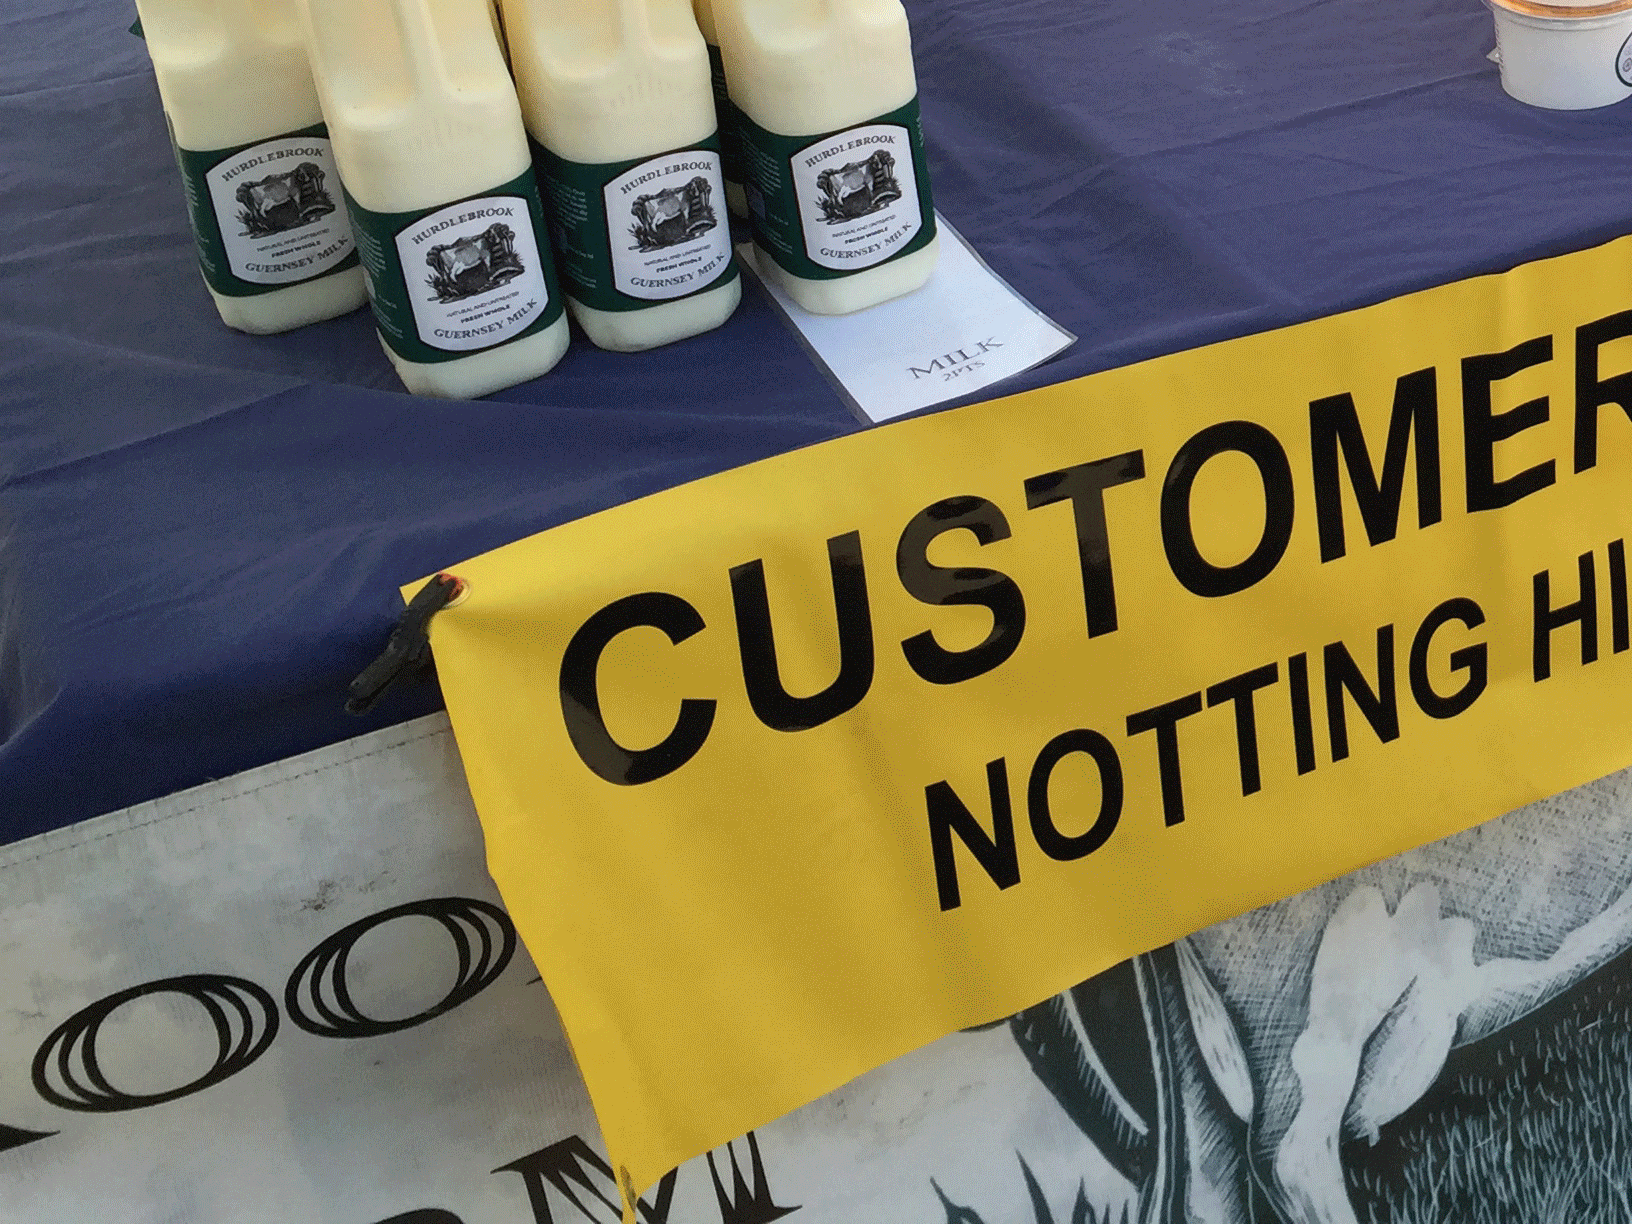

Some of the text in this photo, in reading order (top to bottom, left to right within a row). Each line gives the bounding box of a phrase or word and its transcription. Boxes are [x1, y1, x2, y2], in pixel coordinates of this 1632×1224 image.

[221, 147, 324, 182] HURDLEBROOK
[804, 134, 897, 168] HURDLEBROOK
[620, 161, 713, 195] HURDLEBROOK
[411, 207, 514, 245] HURDLEBROOK
[820, 221, 912, 259] GUERNSEY MILK
[245, 235, 349, 273] GUERNSEY MILK
[630, 251, 726, 288] GUERNSEY MILK
[433, 297, 538, 339] GUERNSEY MILK
[905, 335, 1004, 379] MILK
[943, 359, 986, 382] 2PTS
[923, 597, 1491, 912] NOTTING
